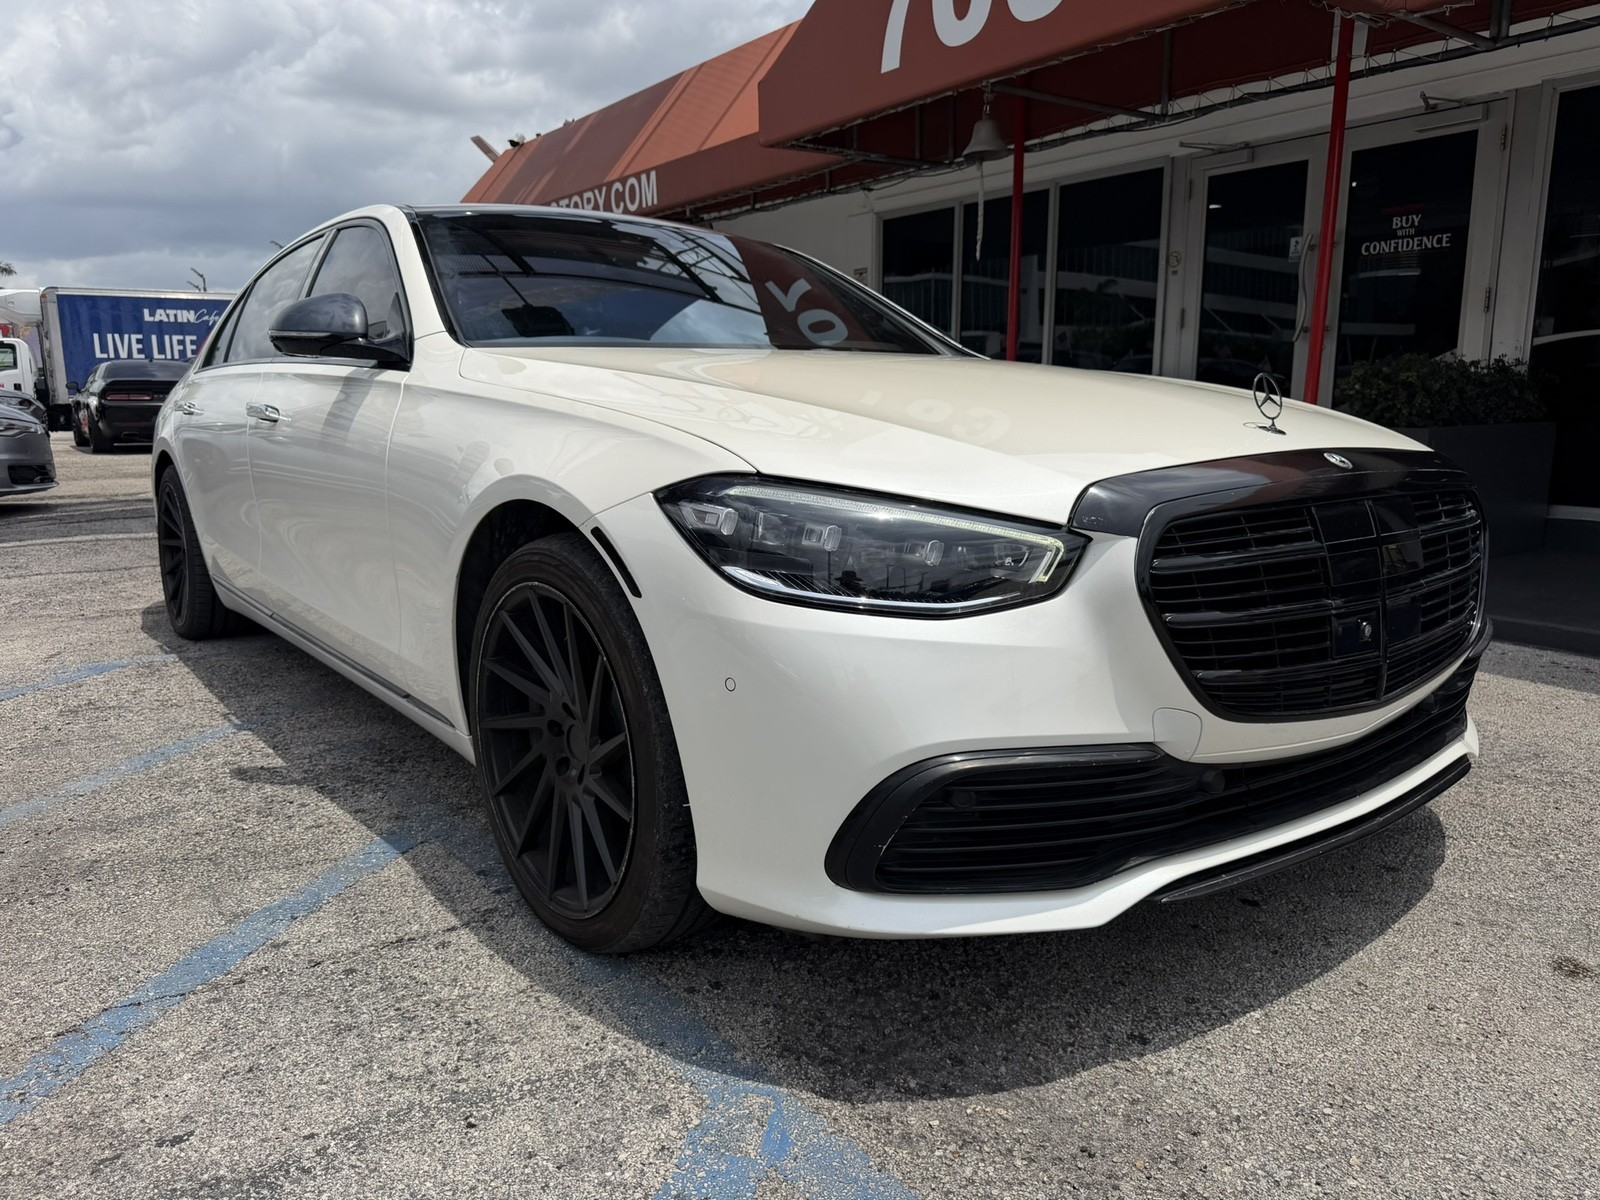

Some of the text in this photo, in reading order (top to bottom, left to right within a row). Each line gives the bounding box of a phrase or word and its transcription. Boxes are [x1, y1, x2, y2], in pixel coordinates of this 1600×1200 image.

[1392, 214, 1422, 229] BUY
[1396, 227, 1415, 237] WITH
[1361, 233, 1452, 256] CONFIDENCE
[143, 308, 195, 322] LATIN
[93, 333, 197, 360] LIVE LIFE
